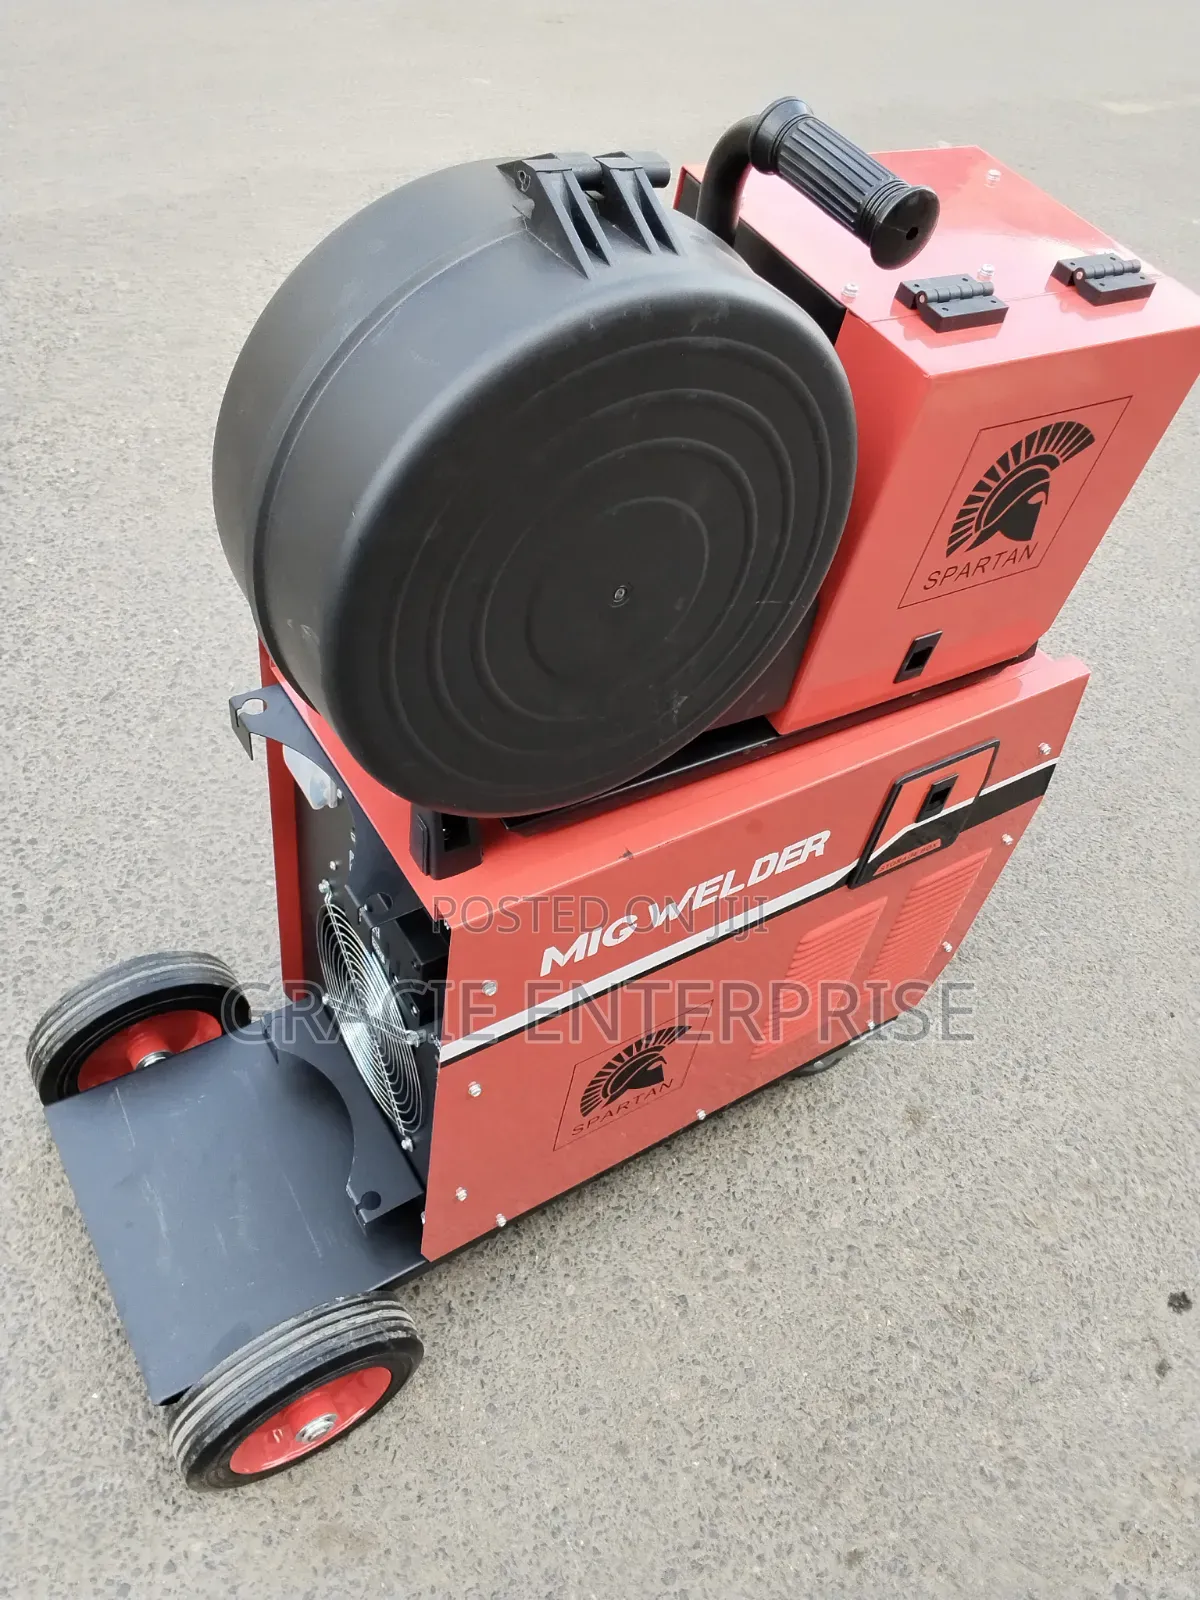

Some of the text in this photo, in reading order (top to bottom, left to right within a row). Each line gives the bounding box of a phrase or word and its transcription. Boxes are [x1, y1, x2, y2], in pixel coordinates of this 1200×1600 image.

[923, 542, 1039, 591] SPARTAN
[540, 829, 831, 977] MIG WELDER
[571, 1078, 675, 1137] SPARTAN
